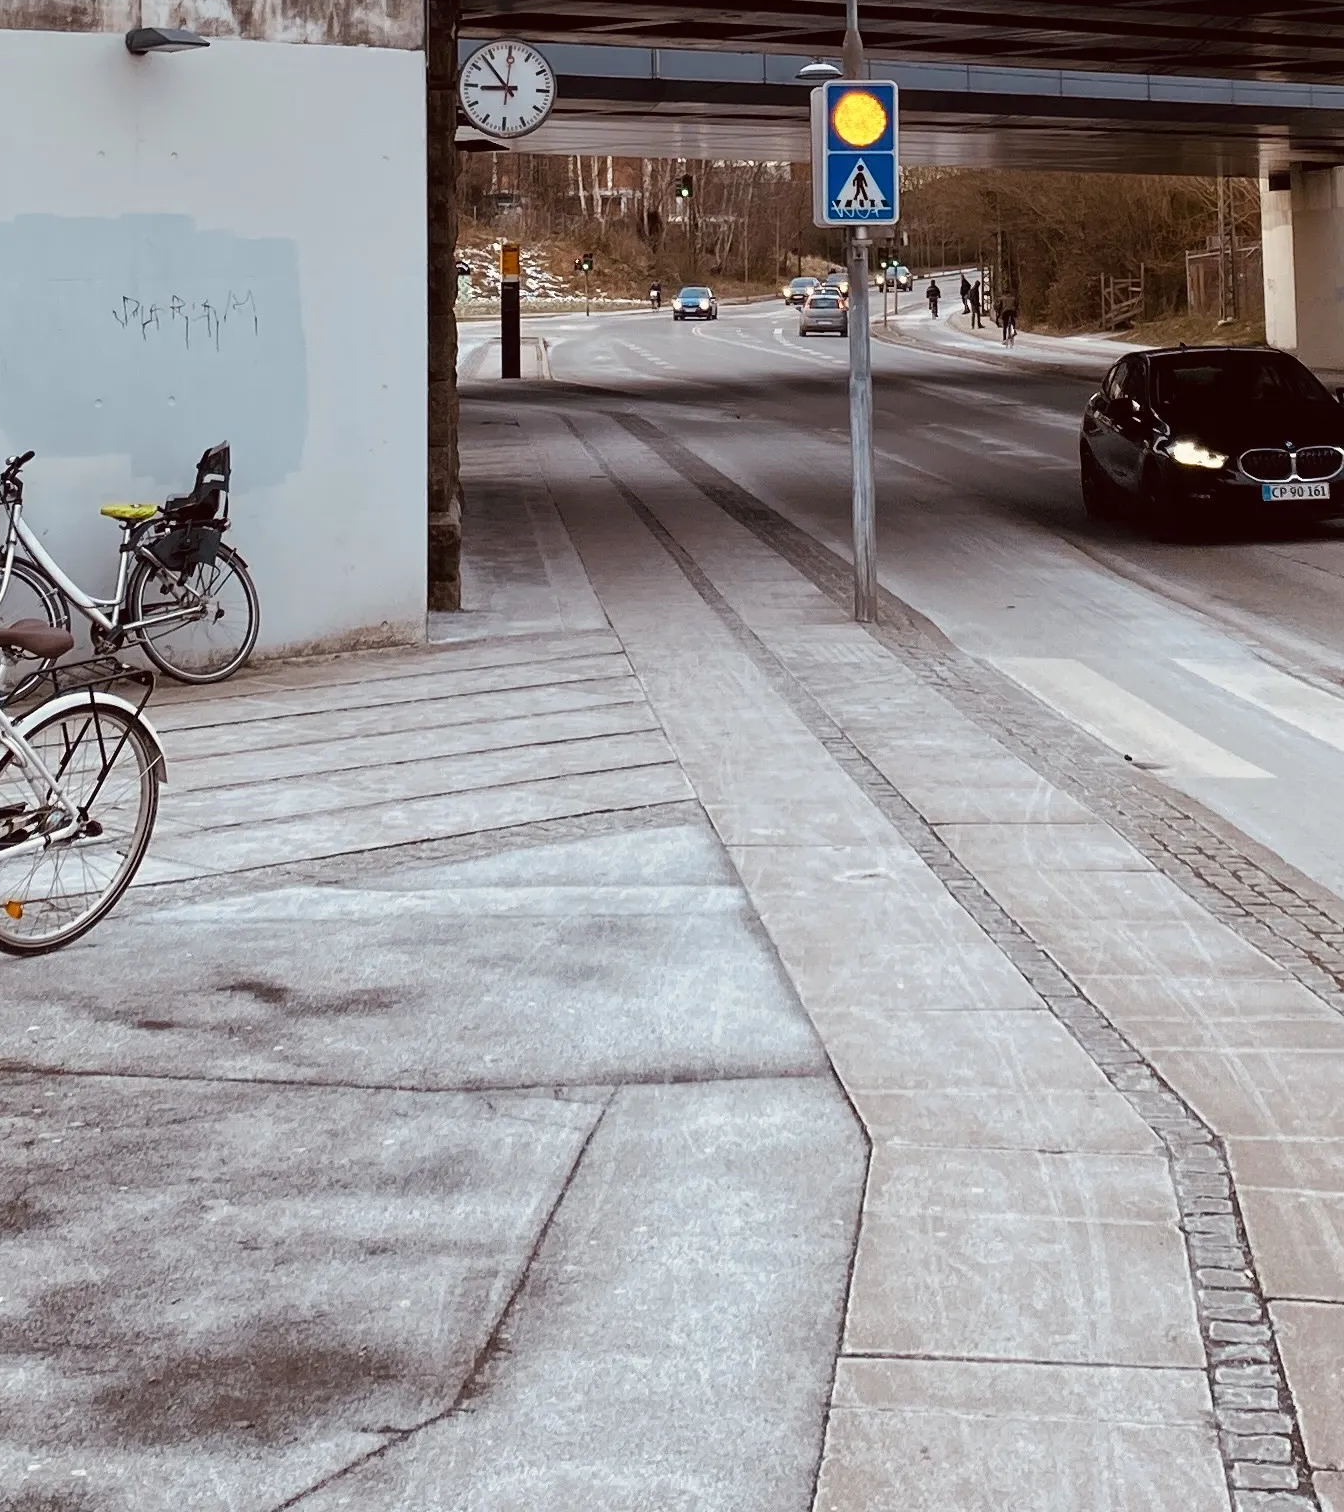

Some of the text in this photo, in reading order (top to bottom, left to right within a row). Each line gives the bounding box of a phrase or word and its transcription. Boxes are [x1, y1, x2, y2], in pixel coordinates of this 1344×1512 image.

[1272, 484, 1326, 498] CP 90 161
